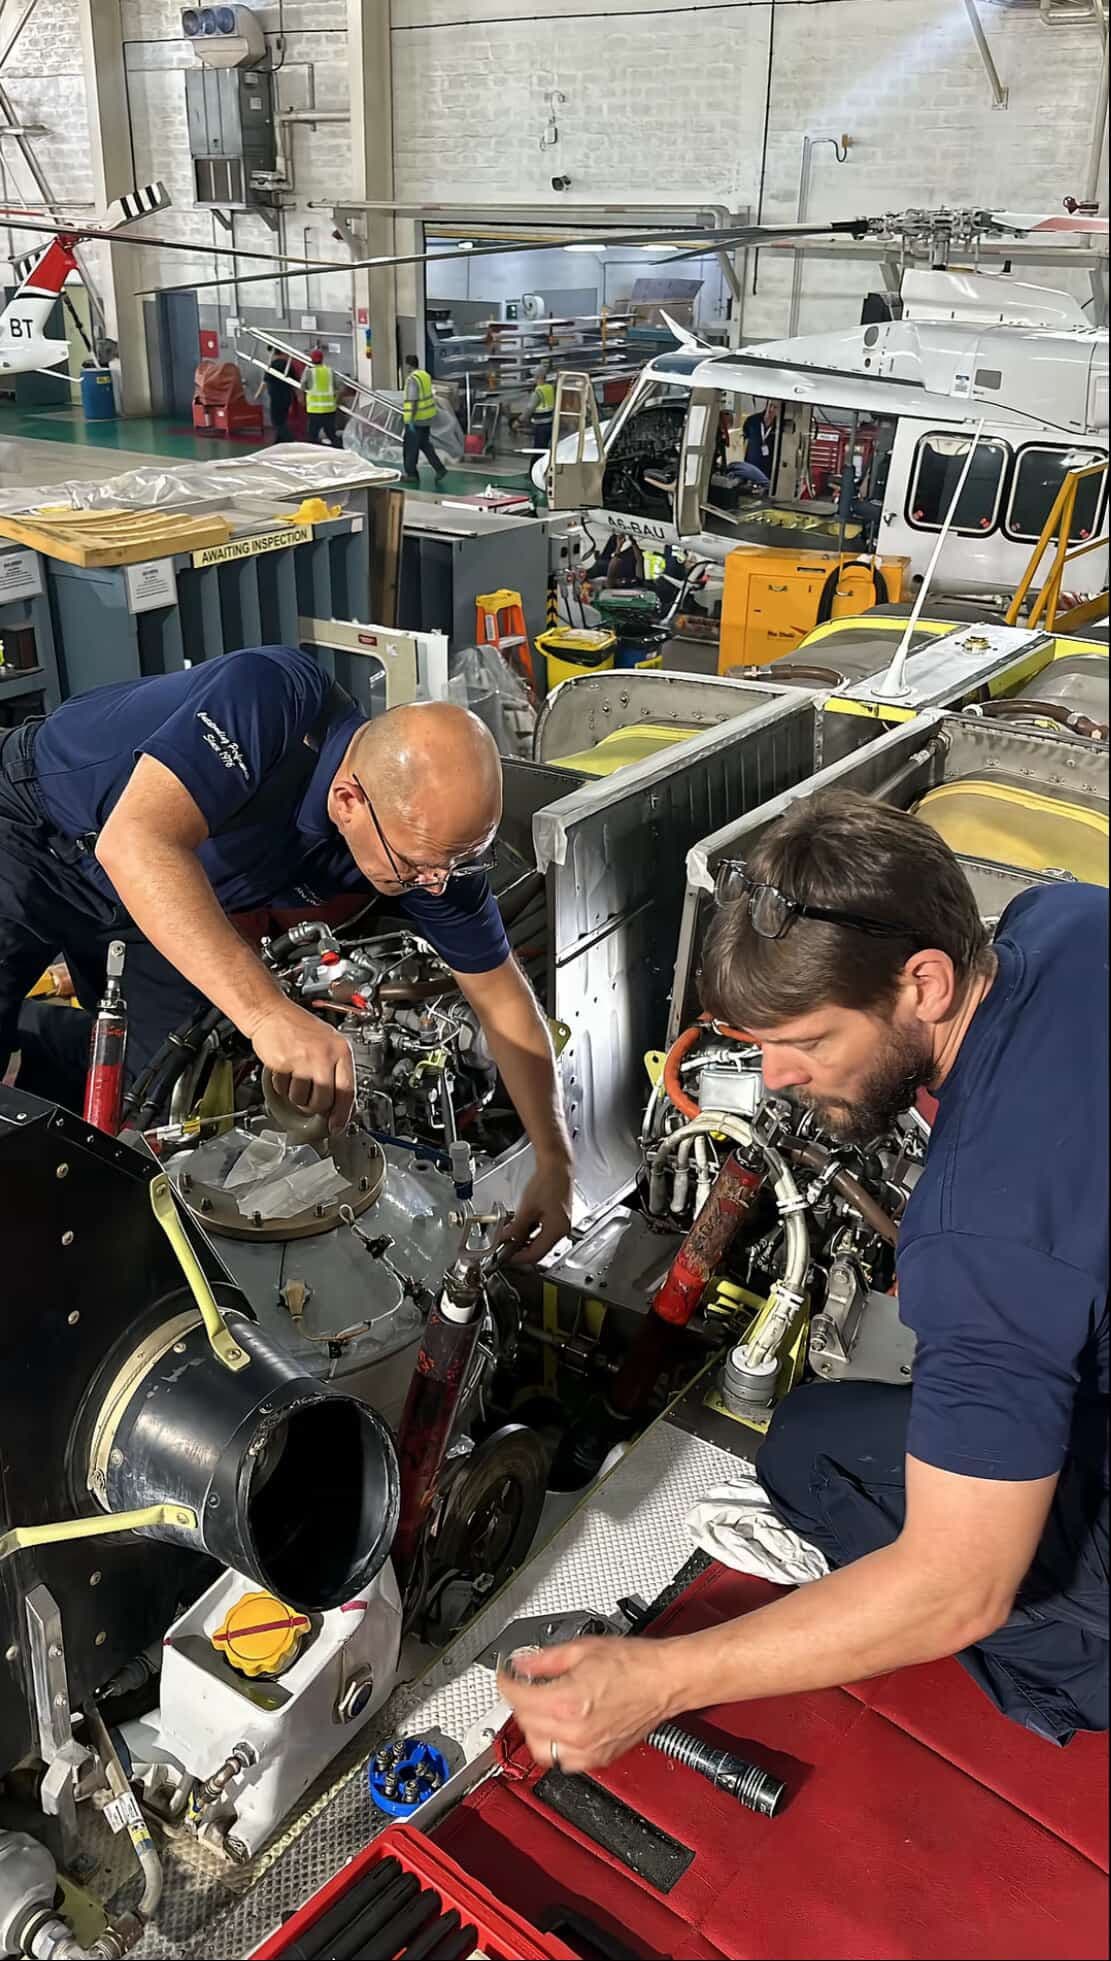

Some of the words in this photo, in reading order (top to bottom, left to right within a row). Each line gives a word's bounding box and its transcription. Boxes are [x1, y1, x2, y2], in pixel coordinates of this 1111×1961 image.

[9, 318, 33, 339] BT
[607, 516, 665, 539] A6-BAU
[202, 542, 250, 564] AWAITING
[253, 529, 308, 551] INSPECTION
